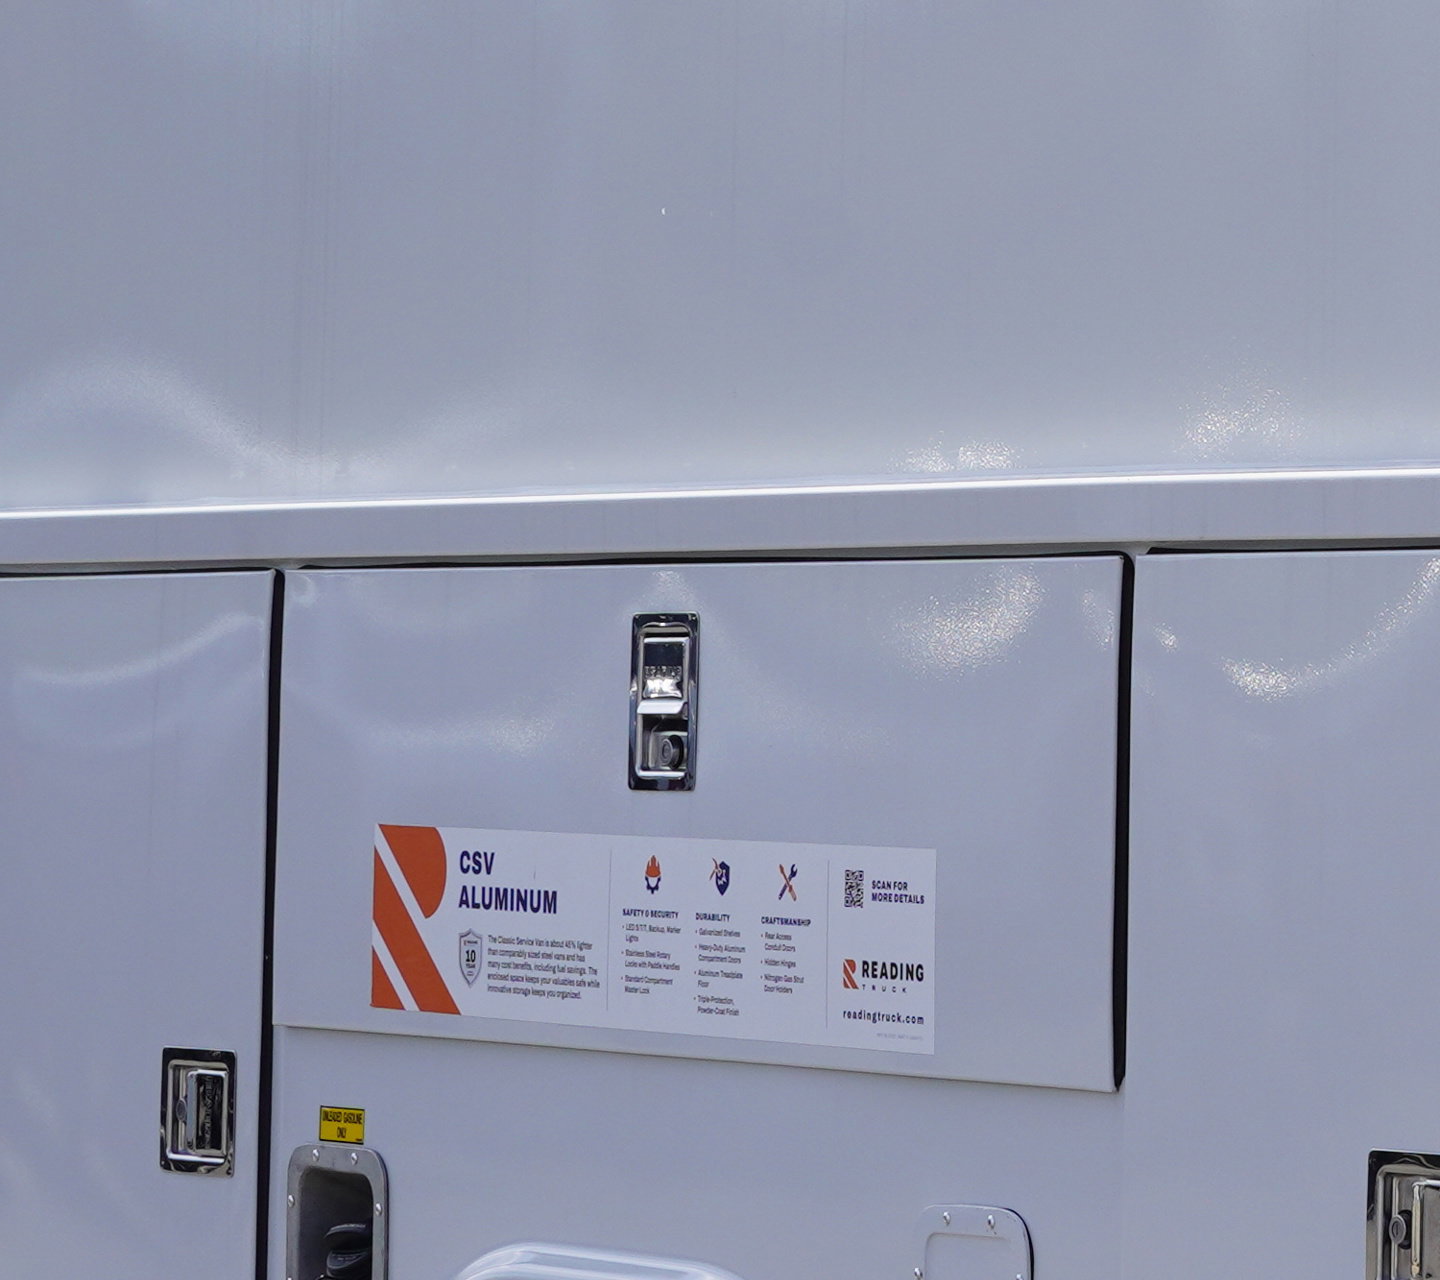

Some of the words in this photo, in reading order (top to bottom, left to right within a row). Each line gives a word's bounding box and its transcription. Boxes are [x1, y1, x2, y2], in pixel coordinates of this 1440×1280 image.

[460, 850, 495, 875] CSV
[871, 880, 892, 891] SCAN
[893, 881, 908, 891] FOR
[459, 884, 558, 914] ALUMINUM
[871, 892, 893, 903] MORE
[894, 894, 925, 905] DETAILS
[622, 908, 644, 917] SAFETY
[650, 910, 679, 919] SECURITY
[695, 912, 730, 922] DURABILITY
[761, 916, 811, 927] CRAFTSMANSHIP
[465, 949, 476, 963] 10
[862, 960, 924, 982] READING
[862, 984, 907, 993] TRUCK
[843, 1009, 924, 1024] readingtruck.com
